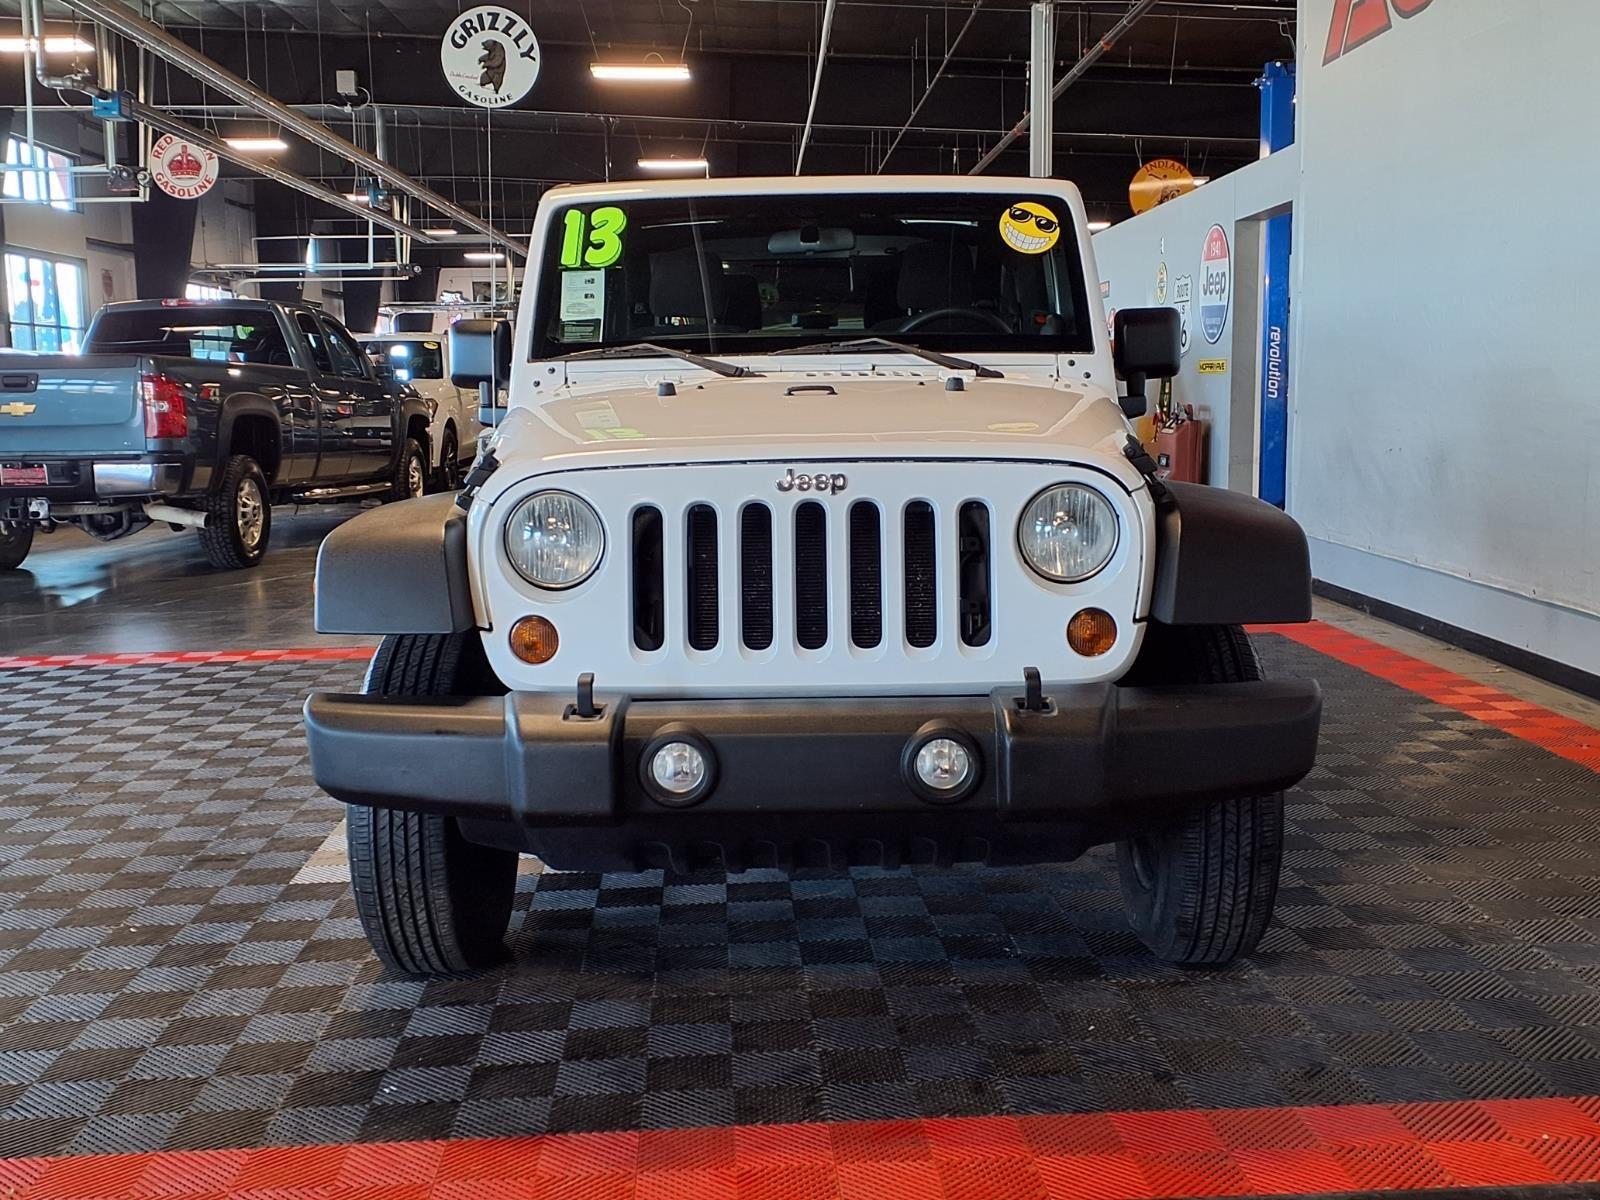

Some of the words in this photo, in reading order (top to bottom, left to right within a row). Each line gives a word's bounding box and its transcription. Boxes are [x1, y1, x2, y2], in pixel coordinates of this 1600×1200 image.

[451, 12, 536, 62] GRIZZLY
[458, 84, 513, 105] GASOLINE
[153, 135, 173, 160] RED
[1145, 160, 1185, 174] INDIAN
[155, 172, 214, 197] GASOLINE
[560, 206, 627, 268] 13
[1203, 266, 1226, 301] Jeep
[1267, 326, 1281, 398] revolution
[775, 468, 848, 495] Jeep
